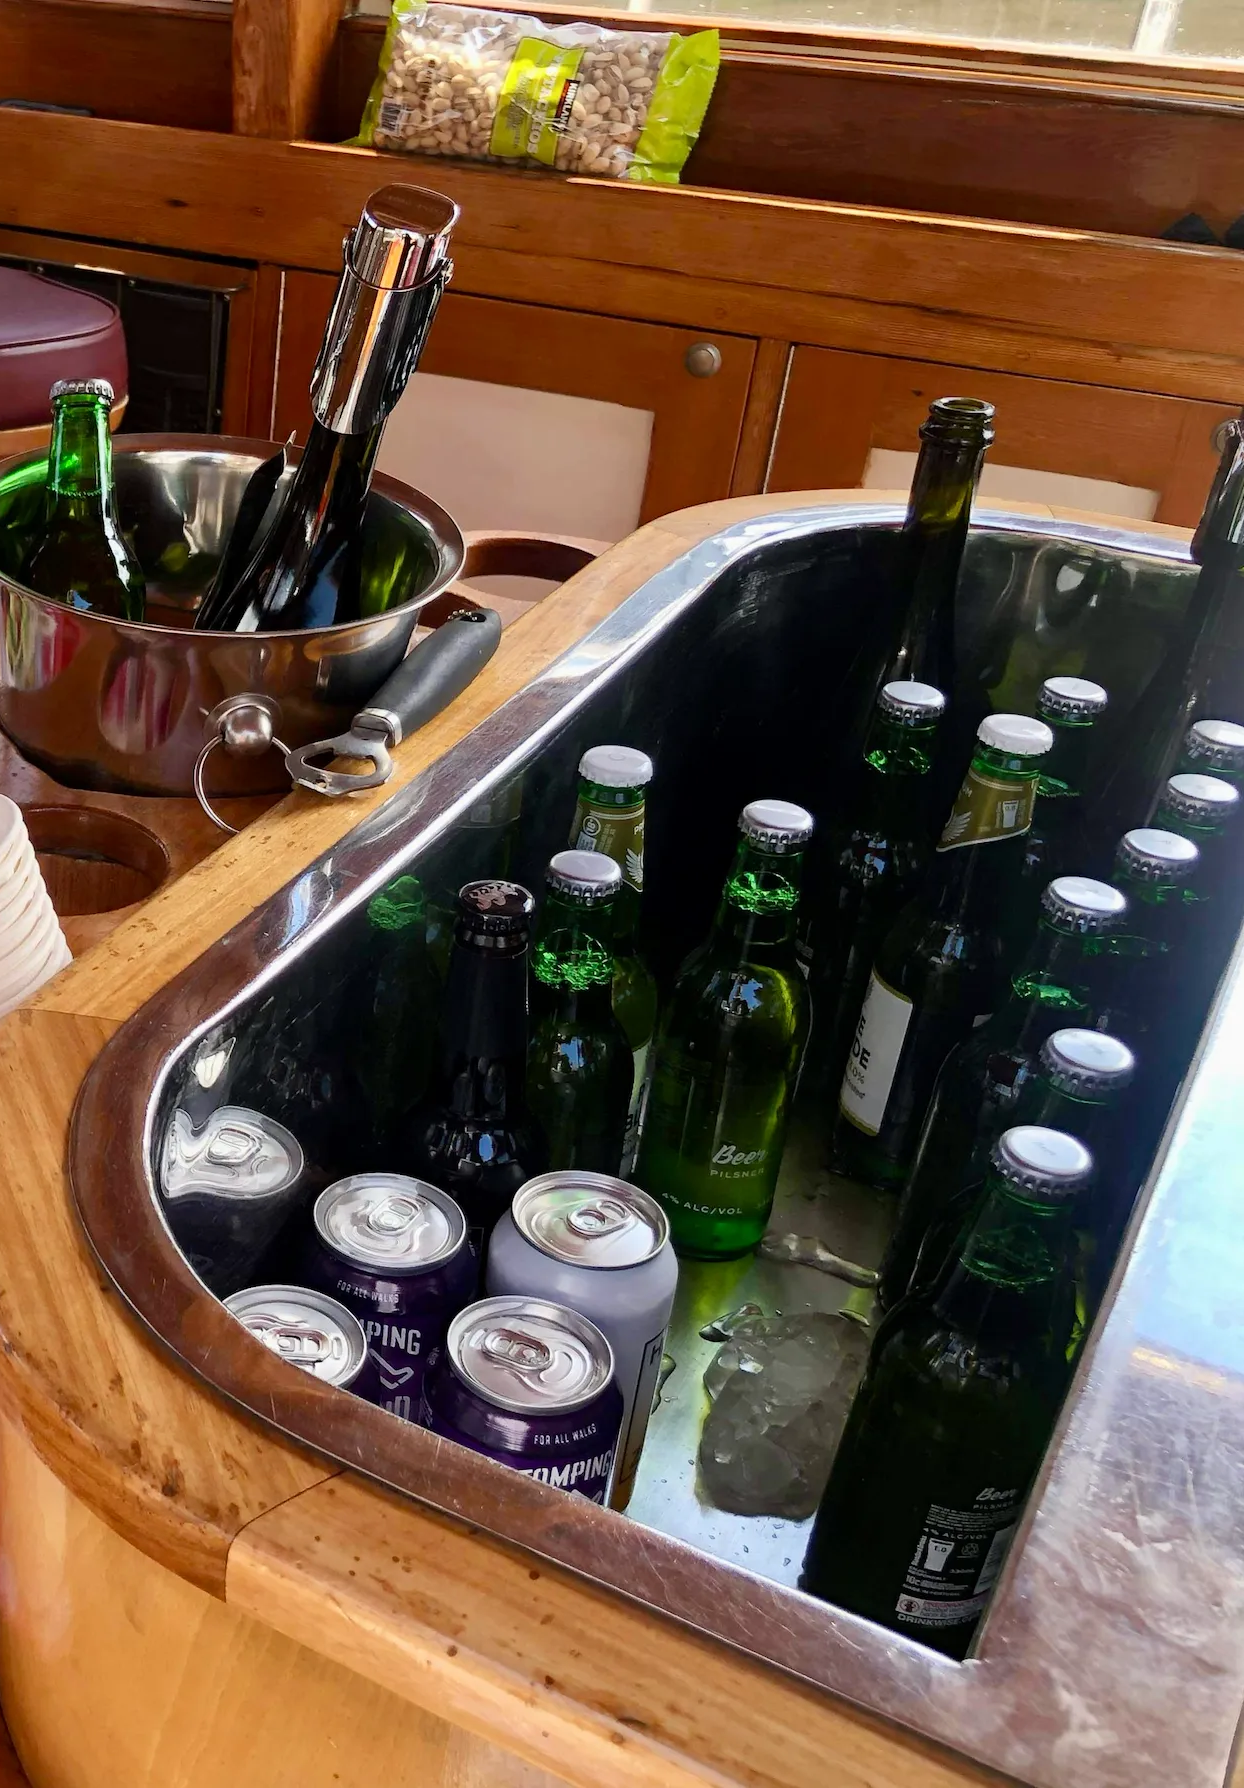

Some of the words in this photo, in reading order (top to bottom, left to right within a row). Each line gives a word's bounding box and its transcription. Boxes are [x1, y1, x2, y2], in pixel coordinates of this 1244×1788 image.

[711, 1144, 769, 1166] Beer
[710, 1168, 765, 1179] PILSNER
[662, 1191, 680, 1205] 4%
[683, 1201, 743, 1215] ALC/VOL
[336, 1279, 352, 1294] FOR
[353, 1286, 368, 1300] ALL
[370, 1291, 401, 1304] WALKS
[360, 1319, 422, 1356] PING
[533, 1434, 551, 1446] FOR
[554, 1433, 570, 1445] ALL
[571, 1423, 598, 1441] WALKS
[972, 1500, 1014, 1510] PILSNER
[975, 1487, 1018, 1501] Beer
